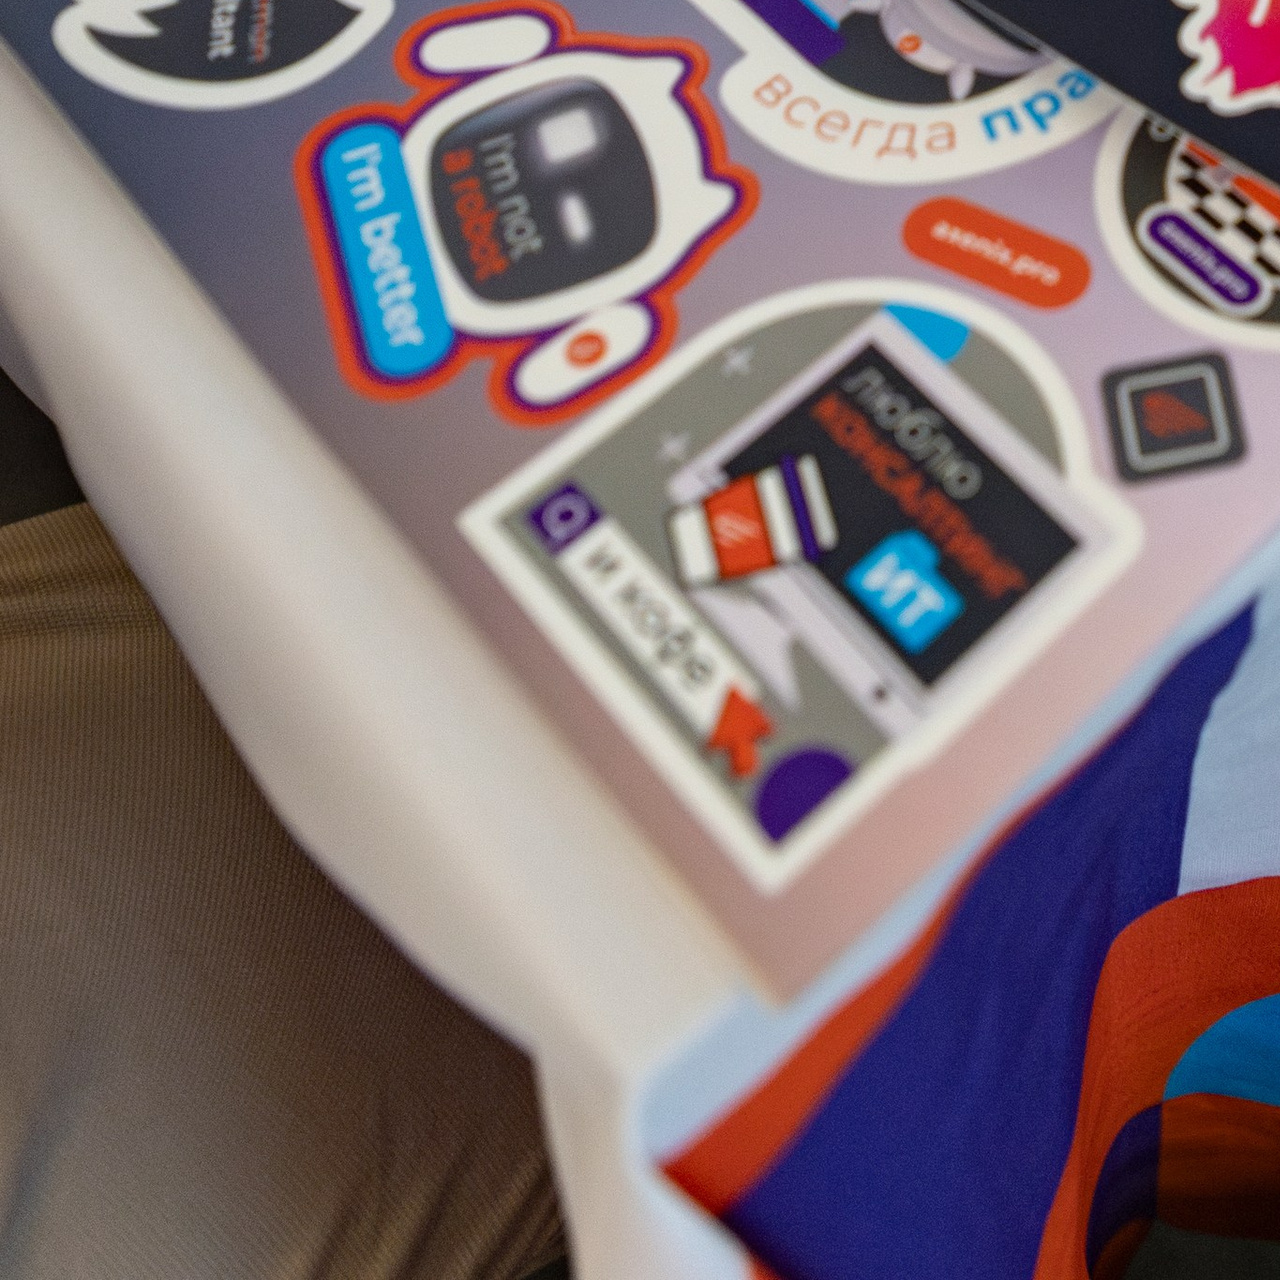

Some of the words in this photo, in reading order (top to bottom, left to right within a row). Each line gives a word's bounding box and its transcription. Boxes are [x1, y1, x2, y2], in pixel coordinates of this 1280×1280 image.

[753, 74, 957, 160] всегда
[341, 142, 386, 212] I'm
[451, 177, 509, 283] robot
[476, 132, 520, 194] I'm
[500, 194, 543, 263] not
[359, 211, 426, 348] better
